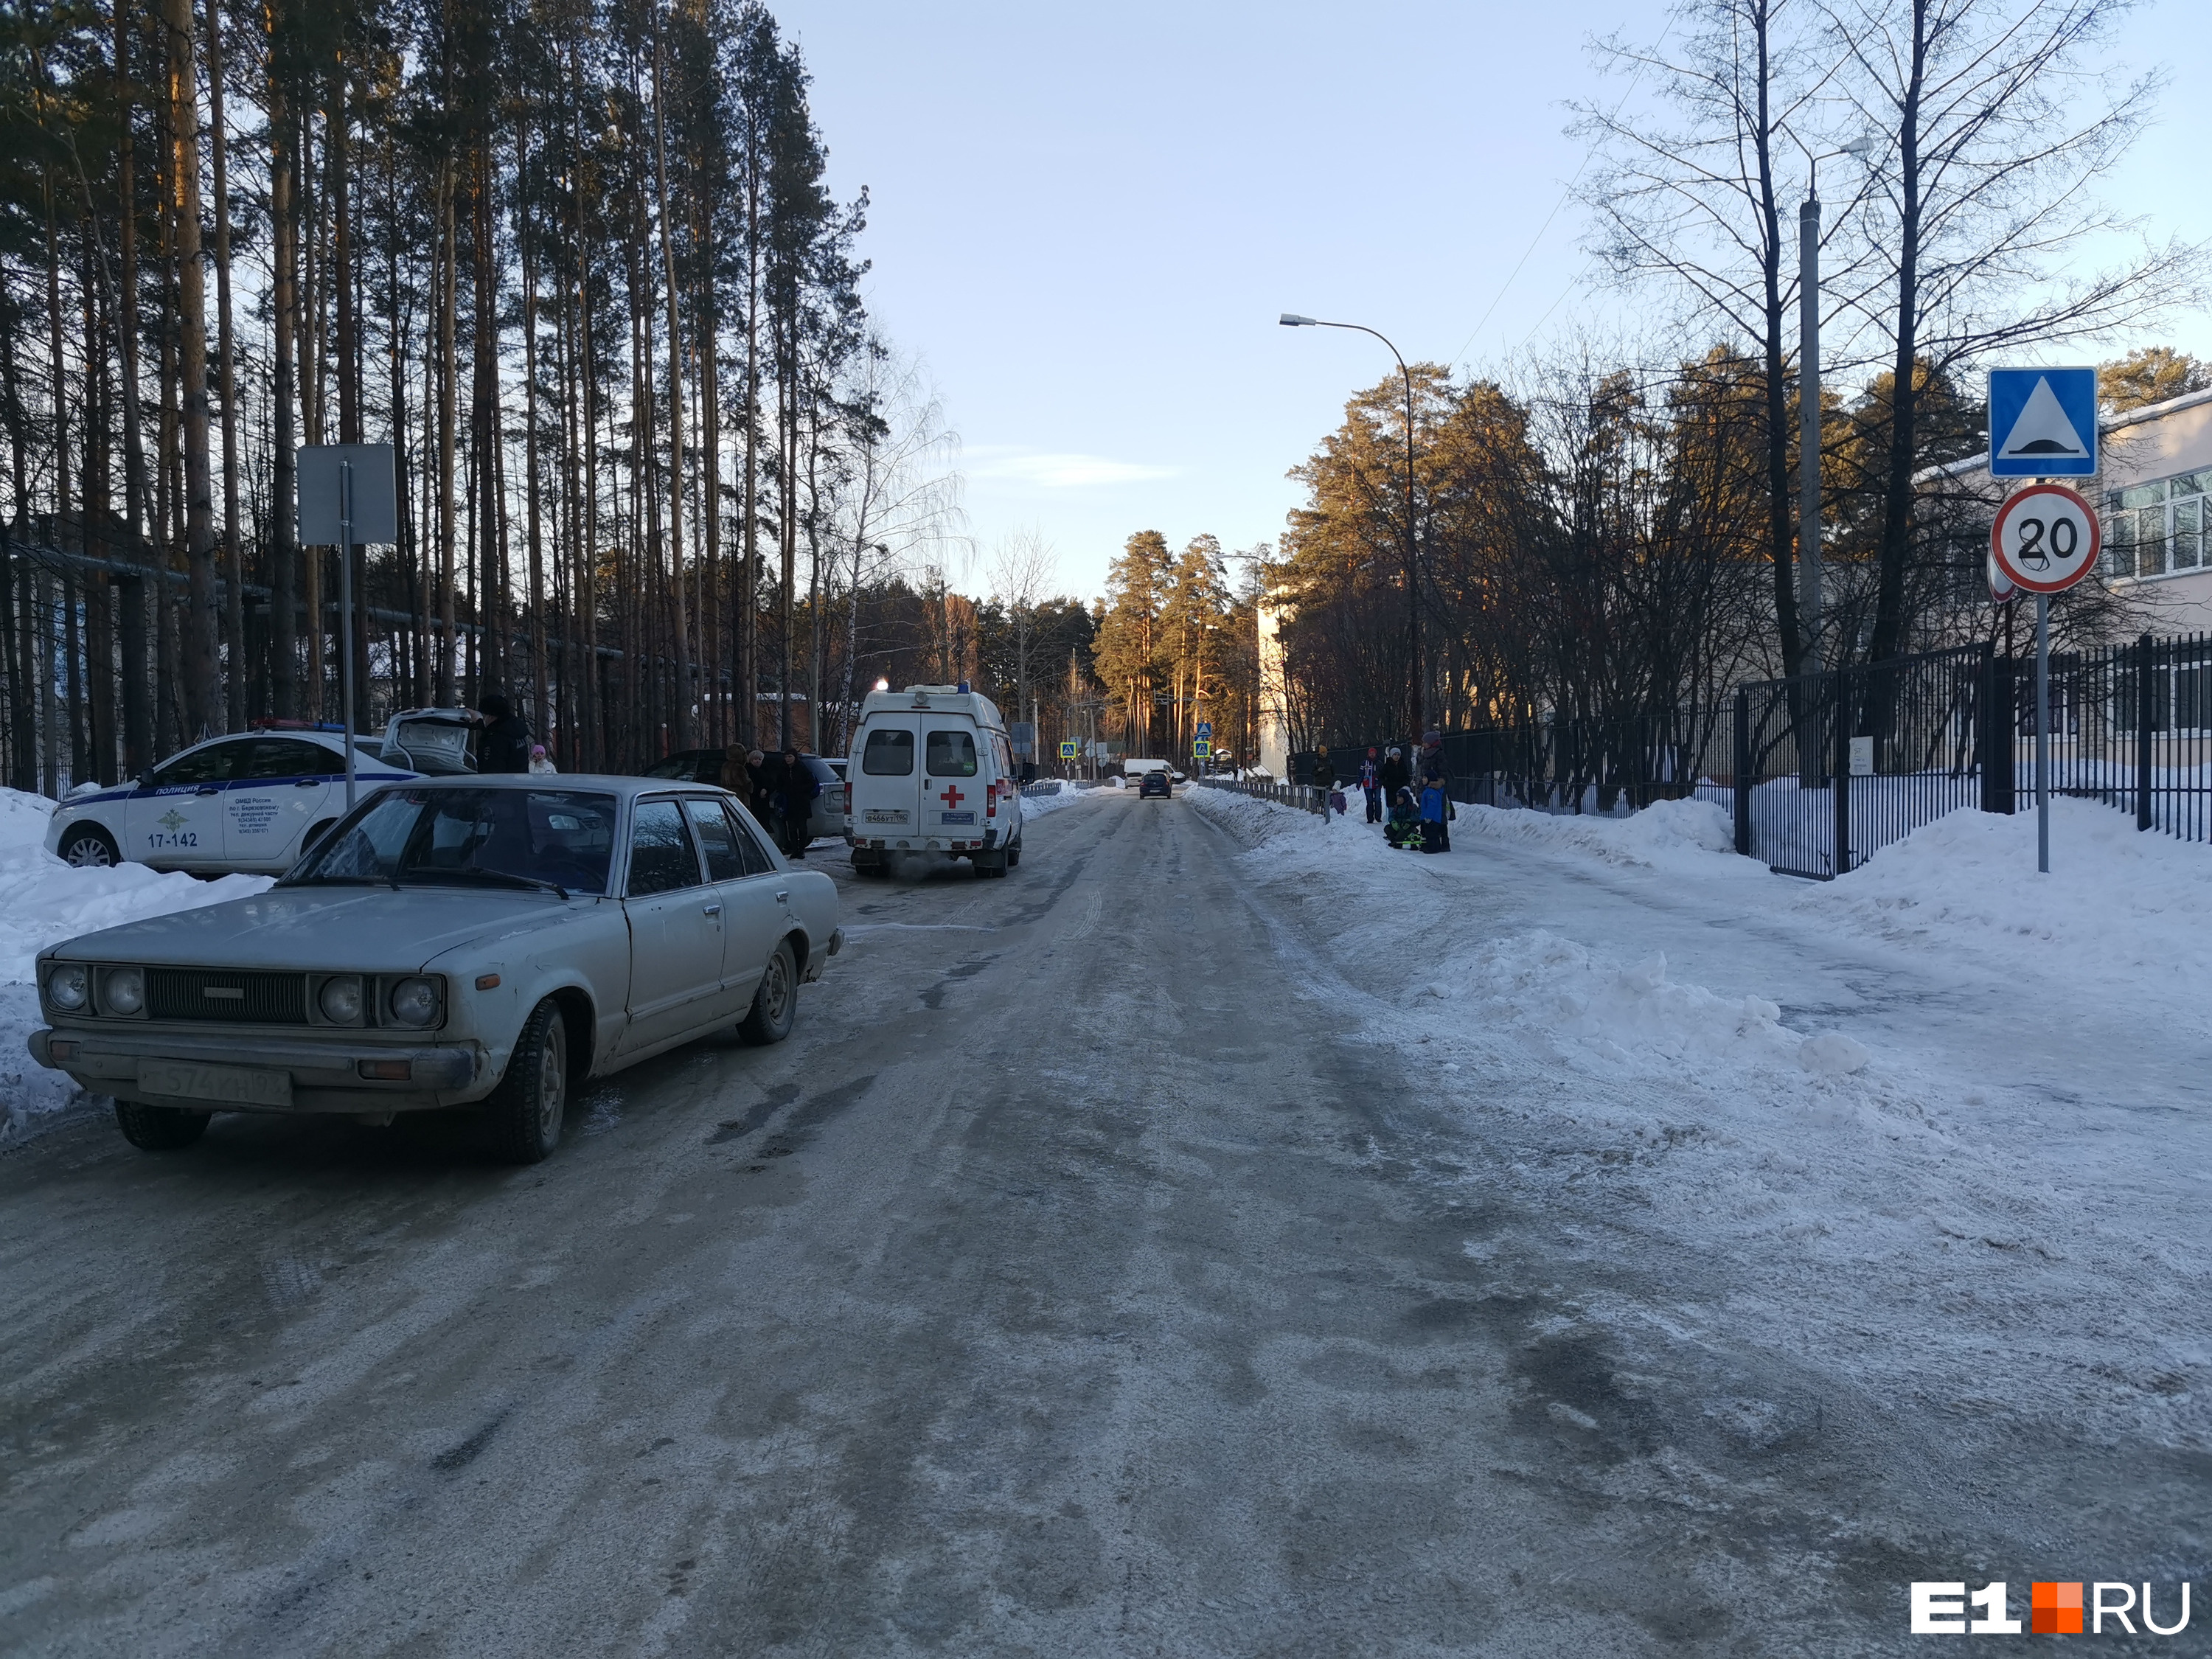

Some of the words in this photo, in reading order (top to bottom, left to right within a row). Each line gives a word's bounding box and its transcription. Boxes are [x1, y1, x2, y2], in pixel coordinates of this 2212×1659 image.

[2019, 518, 2078, 559] 20
[156, 785, 201, 795] ПОЛИЦИЯ
[148, 832, 198, 849] 17-142
